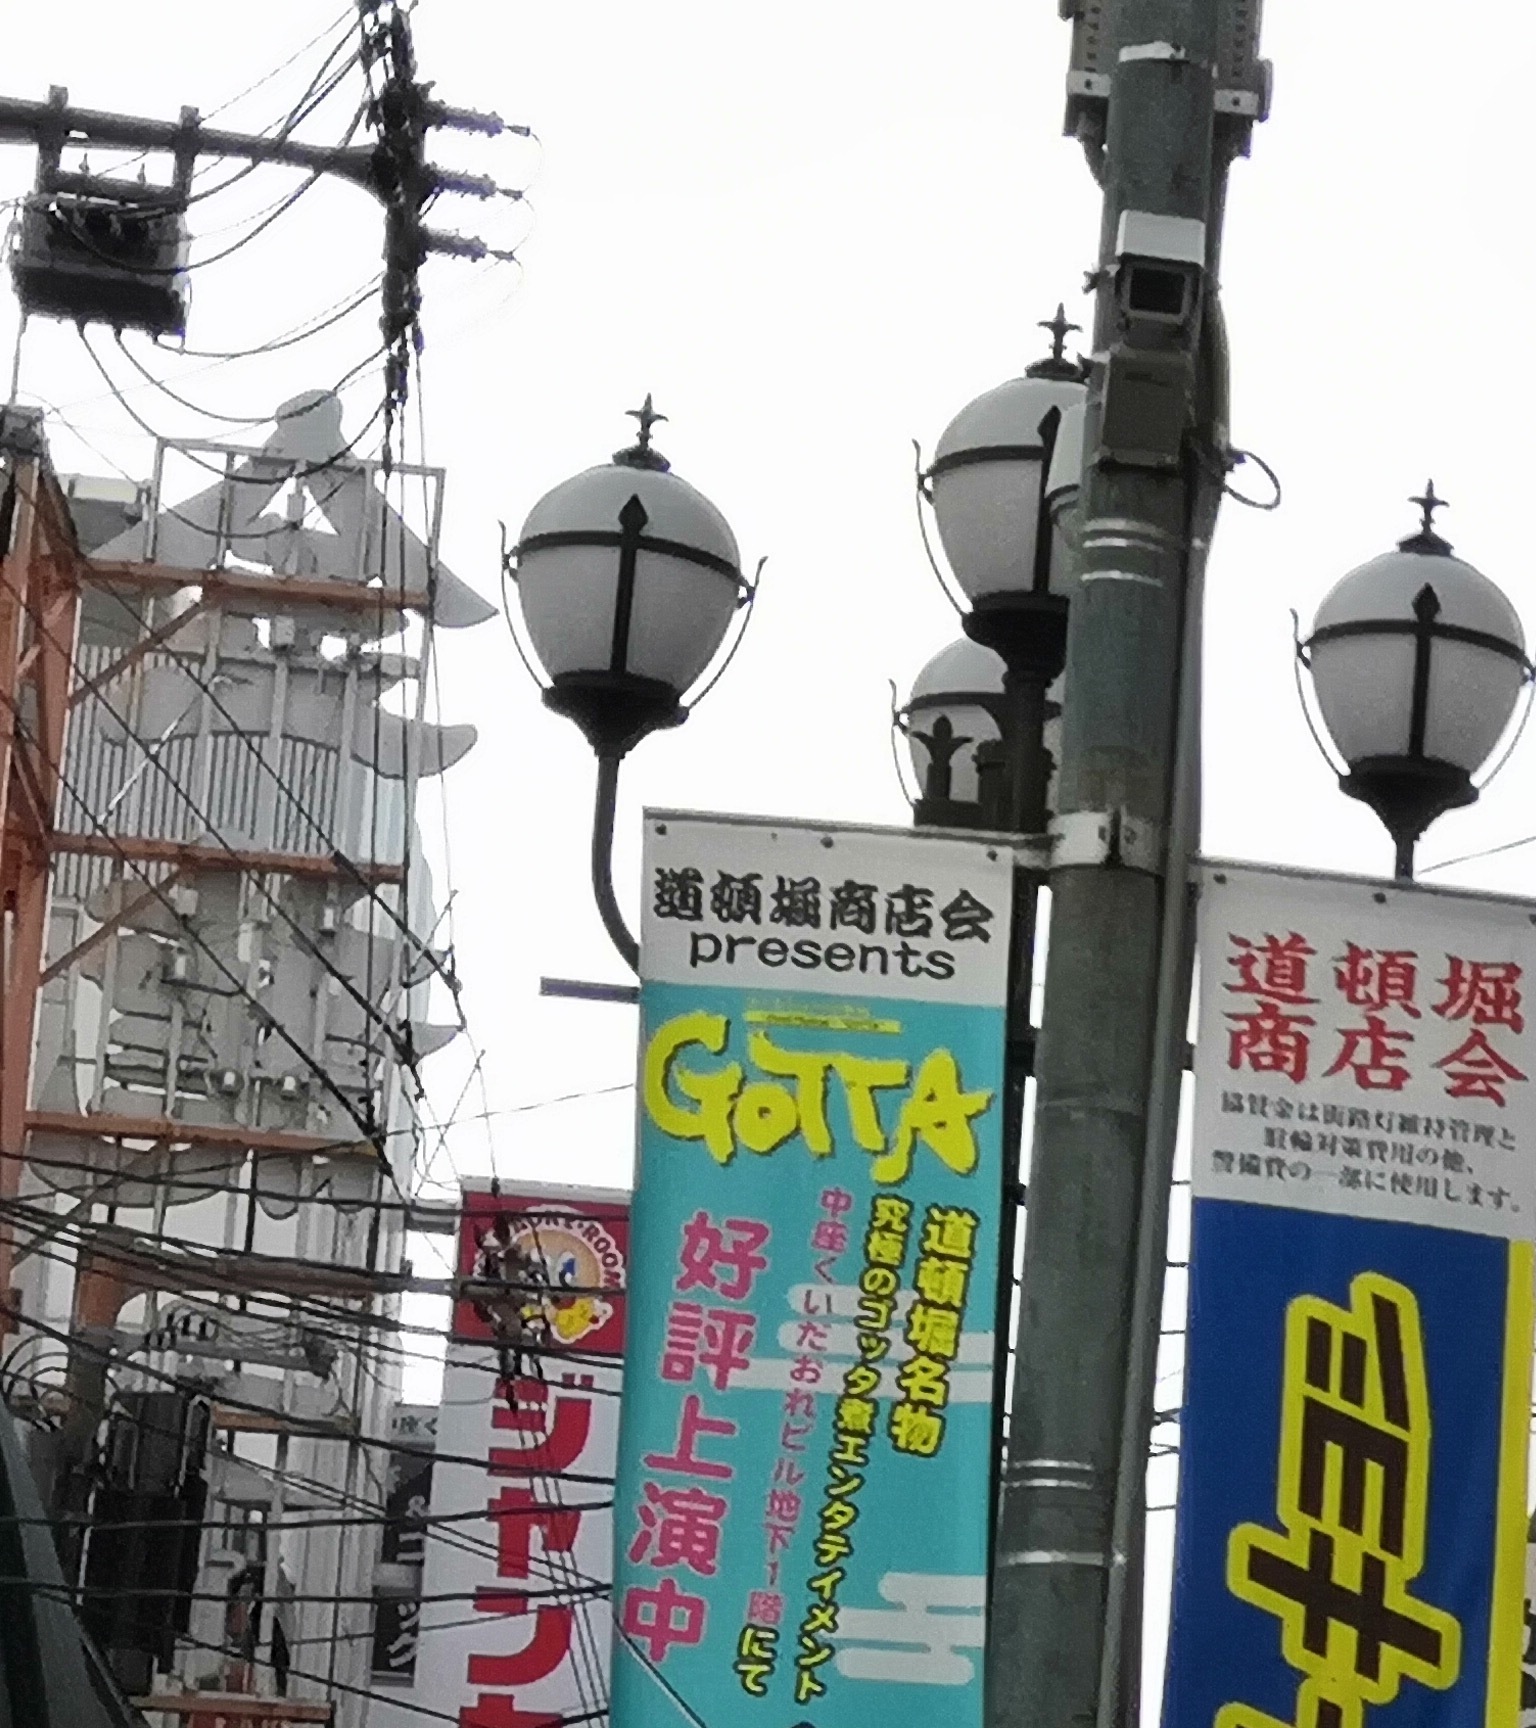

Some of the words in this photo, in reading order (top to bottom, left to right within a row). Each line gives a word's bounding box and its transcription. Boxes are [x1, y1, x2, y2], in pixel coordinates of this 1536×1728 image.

[654, 867, 994, 943] 道頓堀商店会
[690, 931, 956, 979] presents
[1222, 930, 1524, 1034] 道頓堀
[1222, 1000, 1528, 1107] 商店会
[889, 1205, 979, 1457] 道頓堀名物
[620, 1211, 770, 1663] 好評上演中
